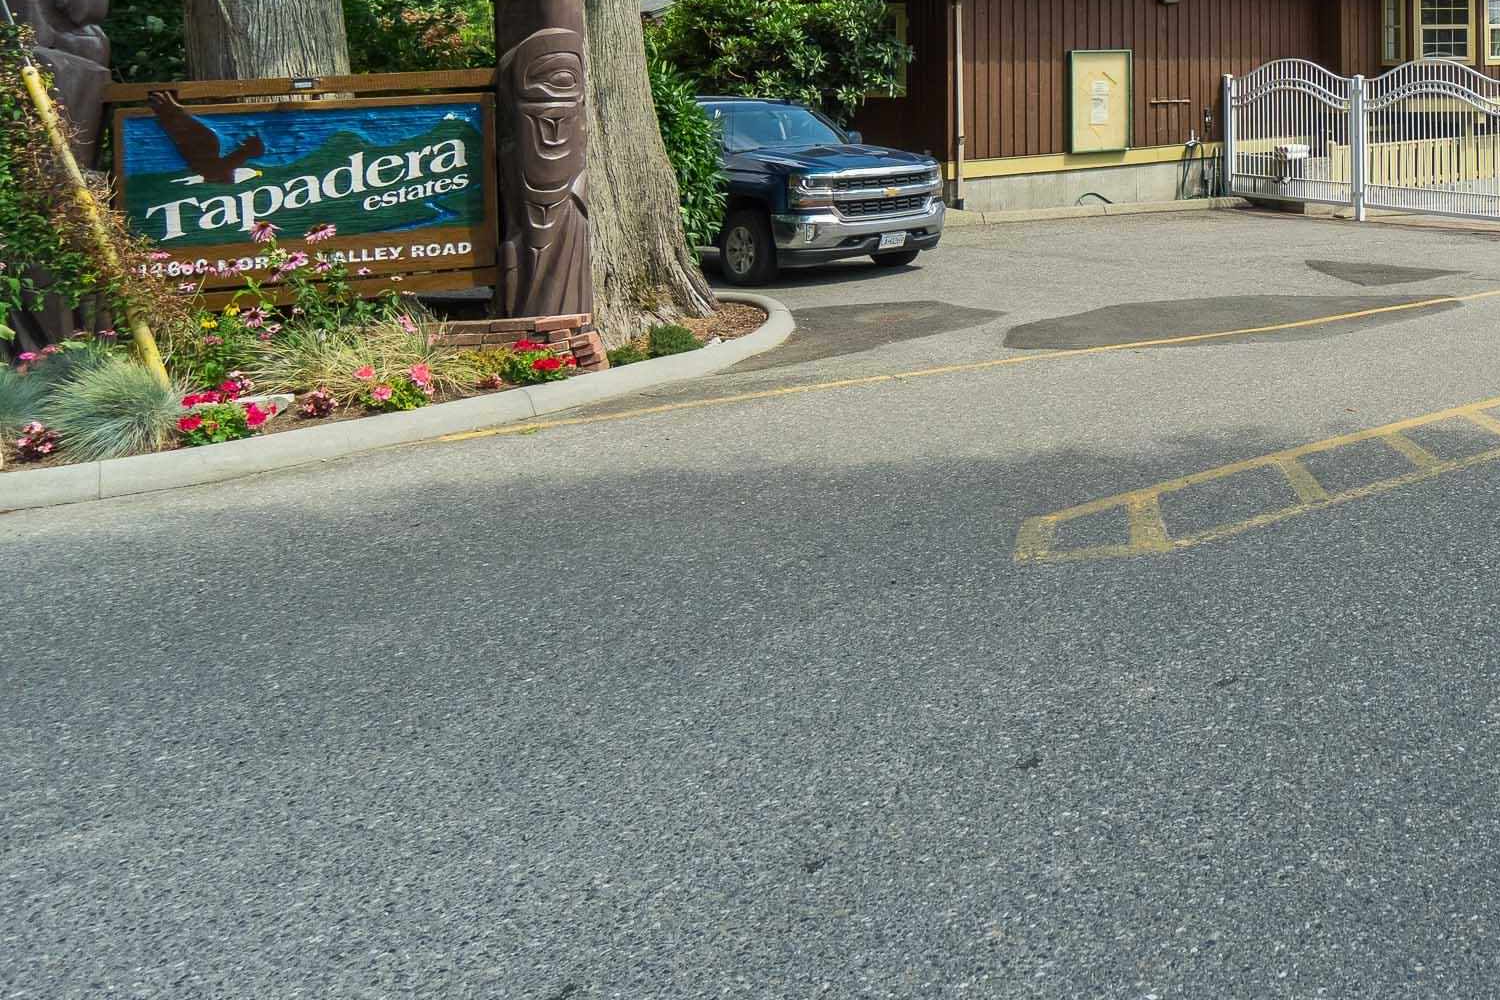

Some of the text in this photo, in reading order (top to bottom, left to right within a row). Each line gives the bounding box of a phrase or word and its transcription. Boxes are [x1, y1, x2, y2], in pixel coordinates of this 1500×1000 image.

[145, 139, 468, 241] Tapadera
[363, 173, 469, 211] estates
[411, 242, 471, 258] ROAD
